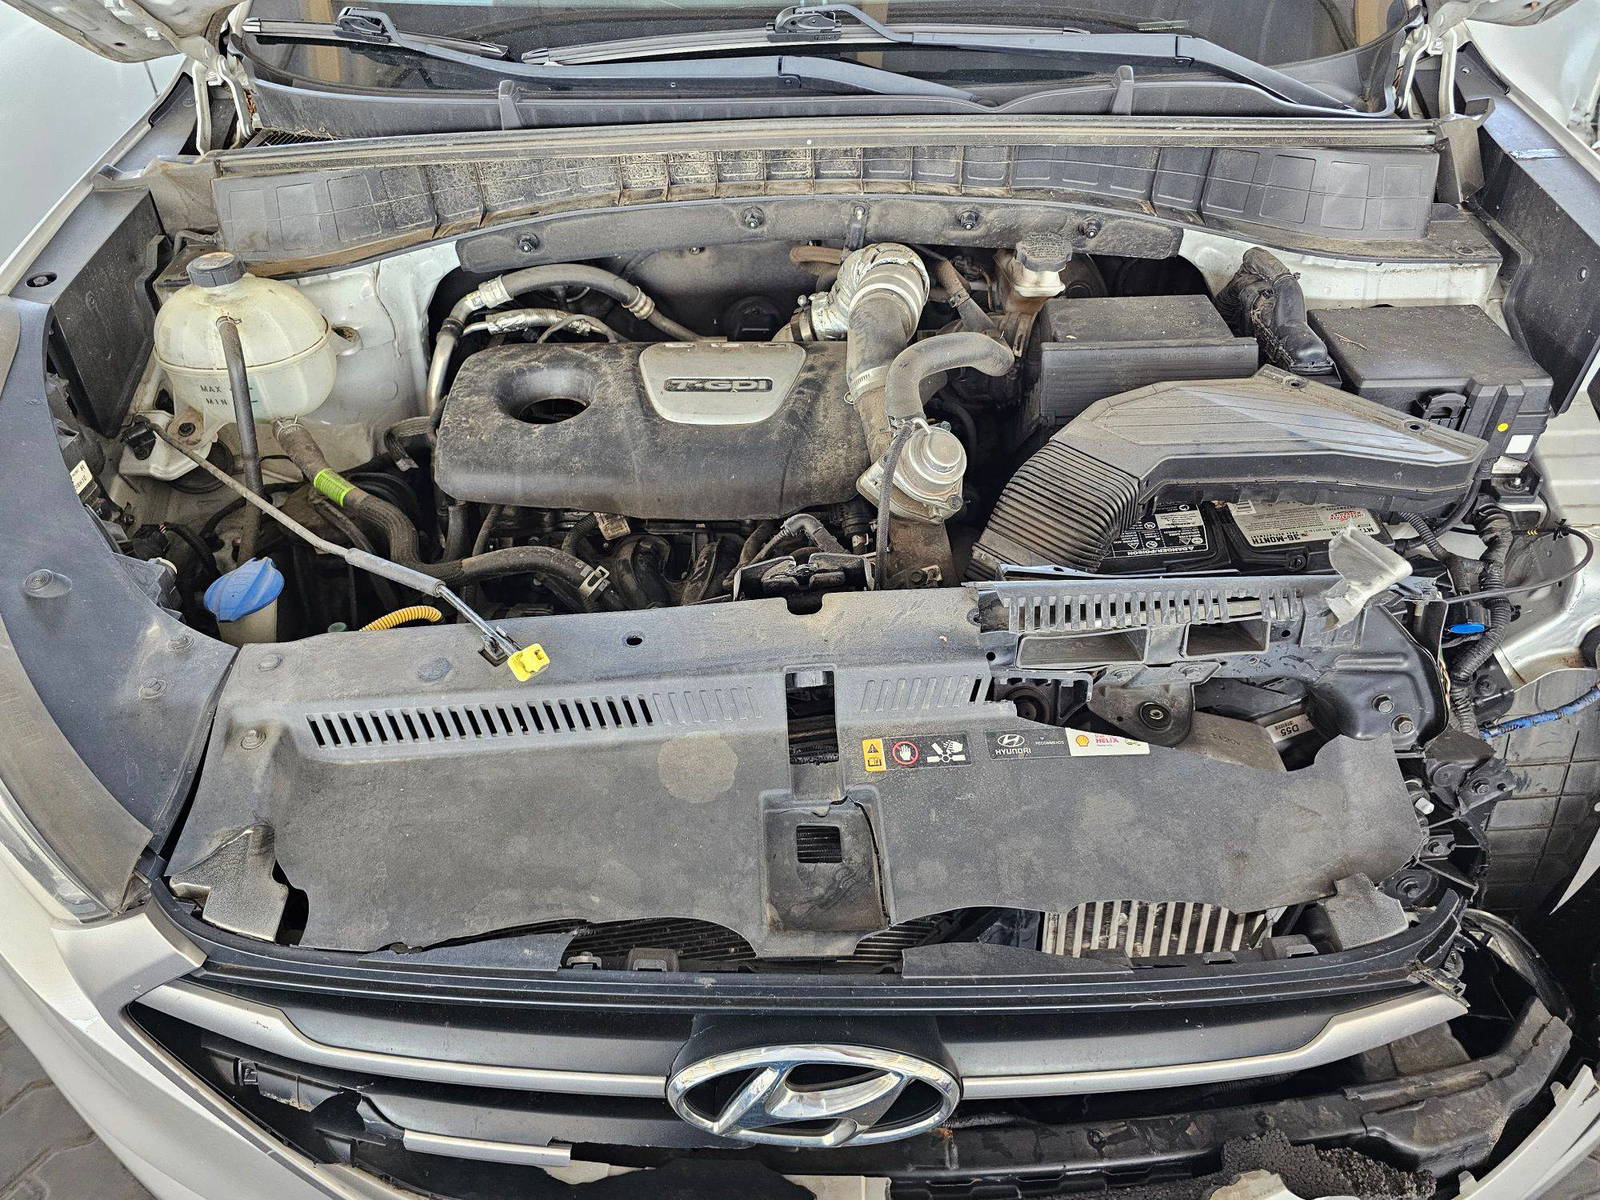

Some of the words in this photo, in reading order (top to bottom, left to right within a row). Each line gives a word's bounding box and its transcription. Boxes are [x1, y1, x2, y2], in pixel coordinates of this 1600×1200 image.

[200, 384, 222, 393] MAX
[205, 397, 228, 406] MIN
[1251, 533, 1300, 545] 36-MONTH
[1280, 723, 1300, 737] D55
[995, 747, 1032, 756] HYUNDAI
